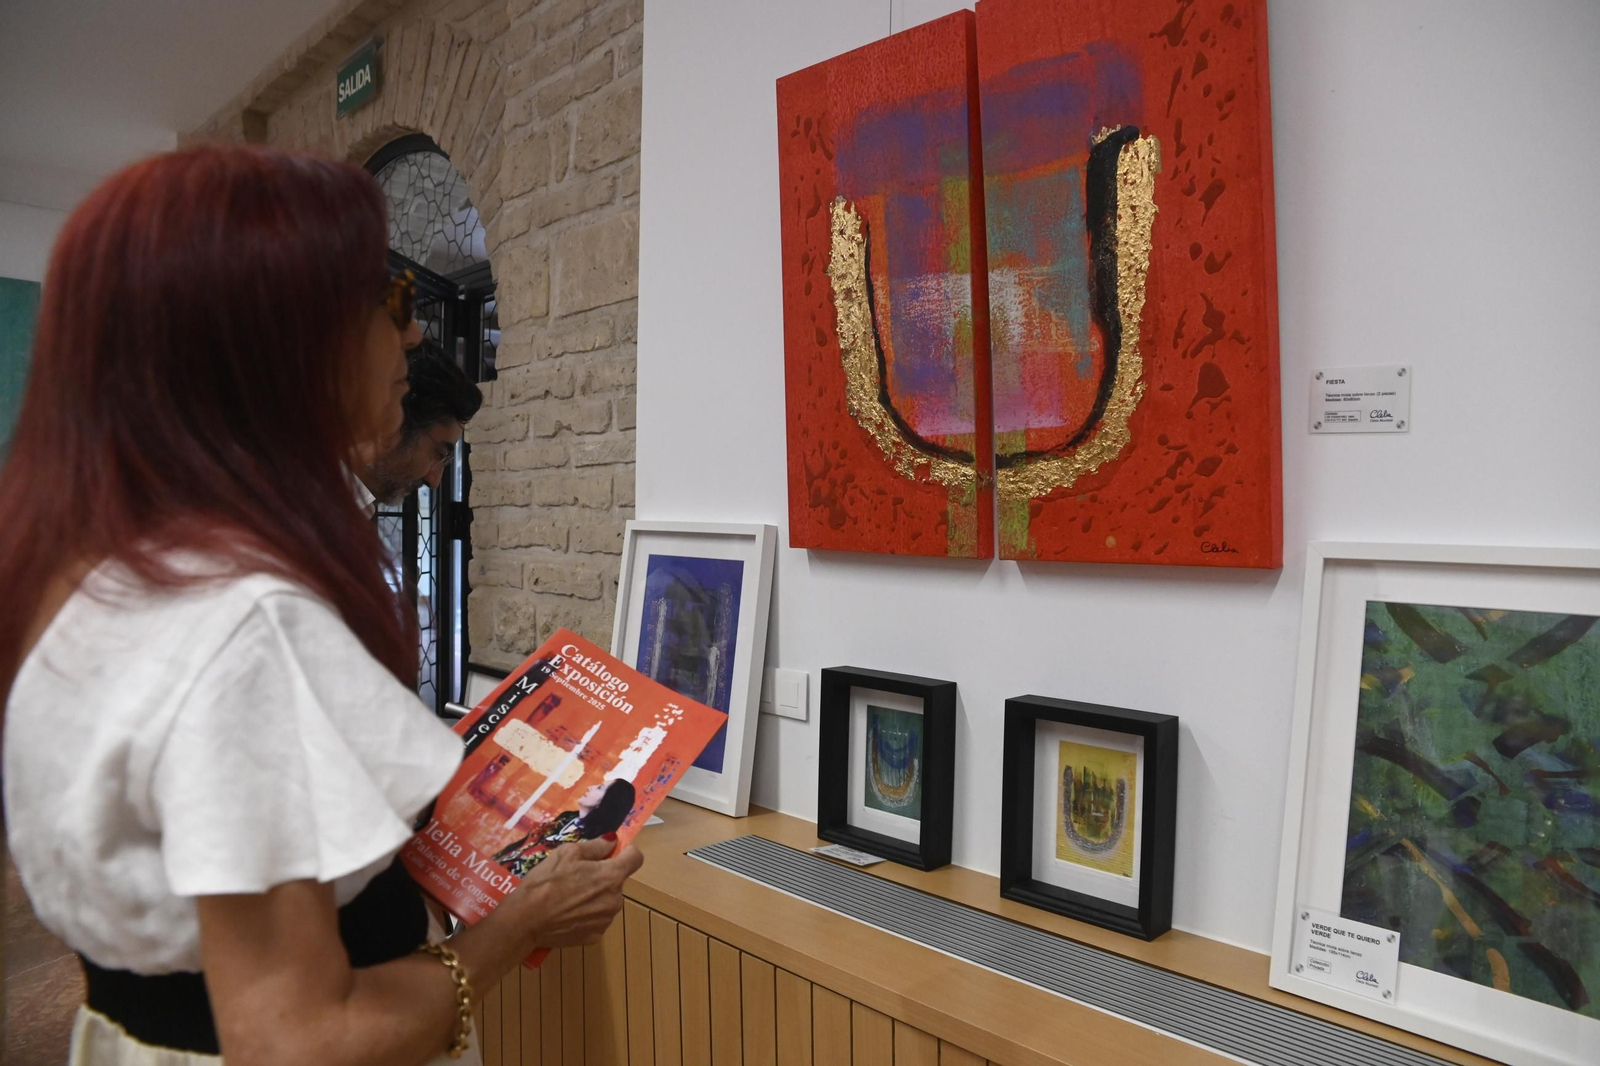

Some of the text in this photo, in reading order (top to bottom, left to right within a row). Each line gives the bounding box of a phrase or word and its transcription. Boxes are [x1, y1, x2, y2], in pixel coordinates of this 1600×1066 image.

[338, 64, 371, 103] SALIDA
[540, 666, 606, 711] 19 Septiembre 2025
[548, 654, 634, 714] Exposición
[561, 644, 629, 692] Catálogo
[425, 817, 463, 858] lelia
[412, 837, 447, 870] Palacio
[446, 867, 460, 881] de
[1310, 929, 1331, 939] VERDE
[1311, 922, 1381, 946] VERDE QUE TE QUIERO
